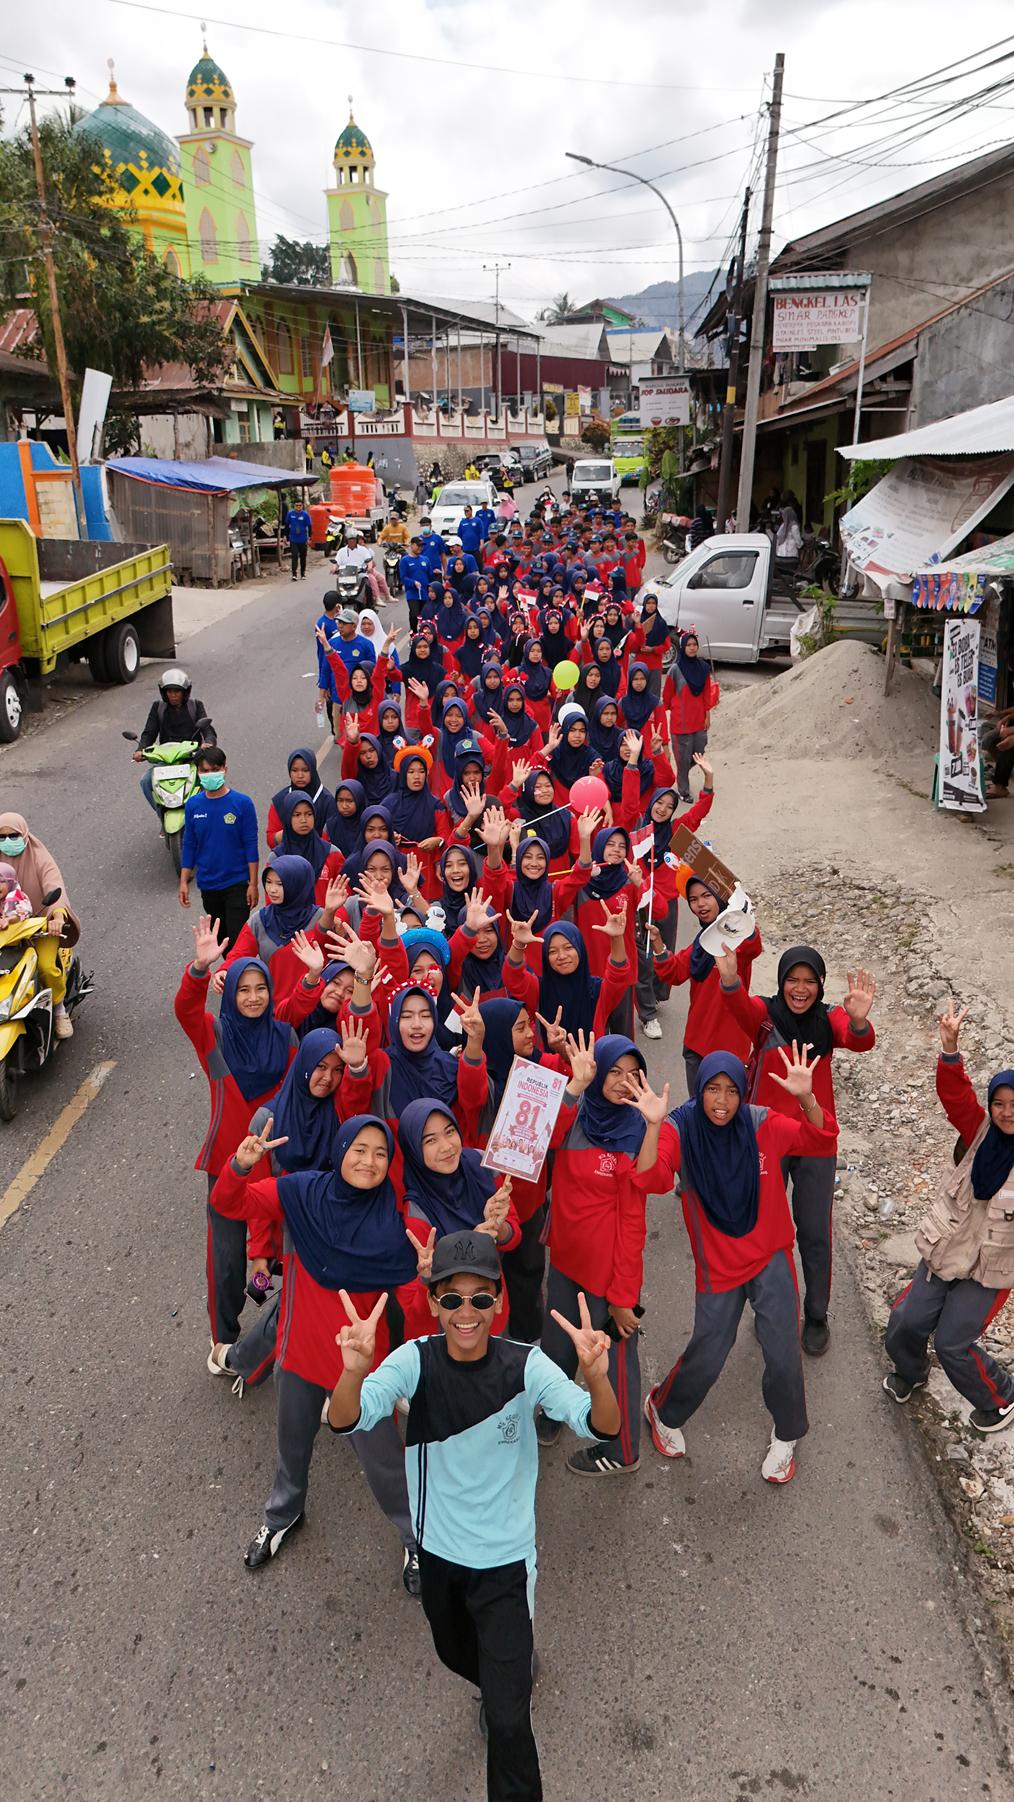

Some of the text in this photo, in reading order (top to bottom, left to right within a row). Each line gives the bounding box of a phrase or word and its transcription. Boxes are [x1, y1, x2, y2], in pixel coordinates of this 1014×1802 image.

[776, 295, 858, 310] BENGKEL LAS
[778, 310, 811, 322] SINAR
[517, 1080, 549, 1098] INDONESIA
[526, 1077, 549, 1089] REPUBLIK
[552, 1078, 563, 1091] 81
[515, 1100, 541, 1130] 81
